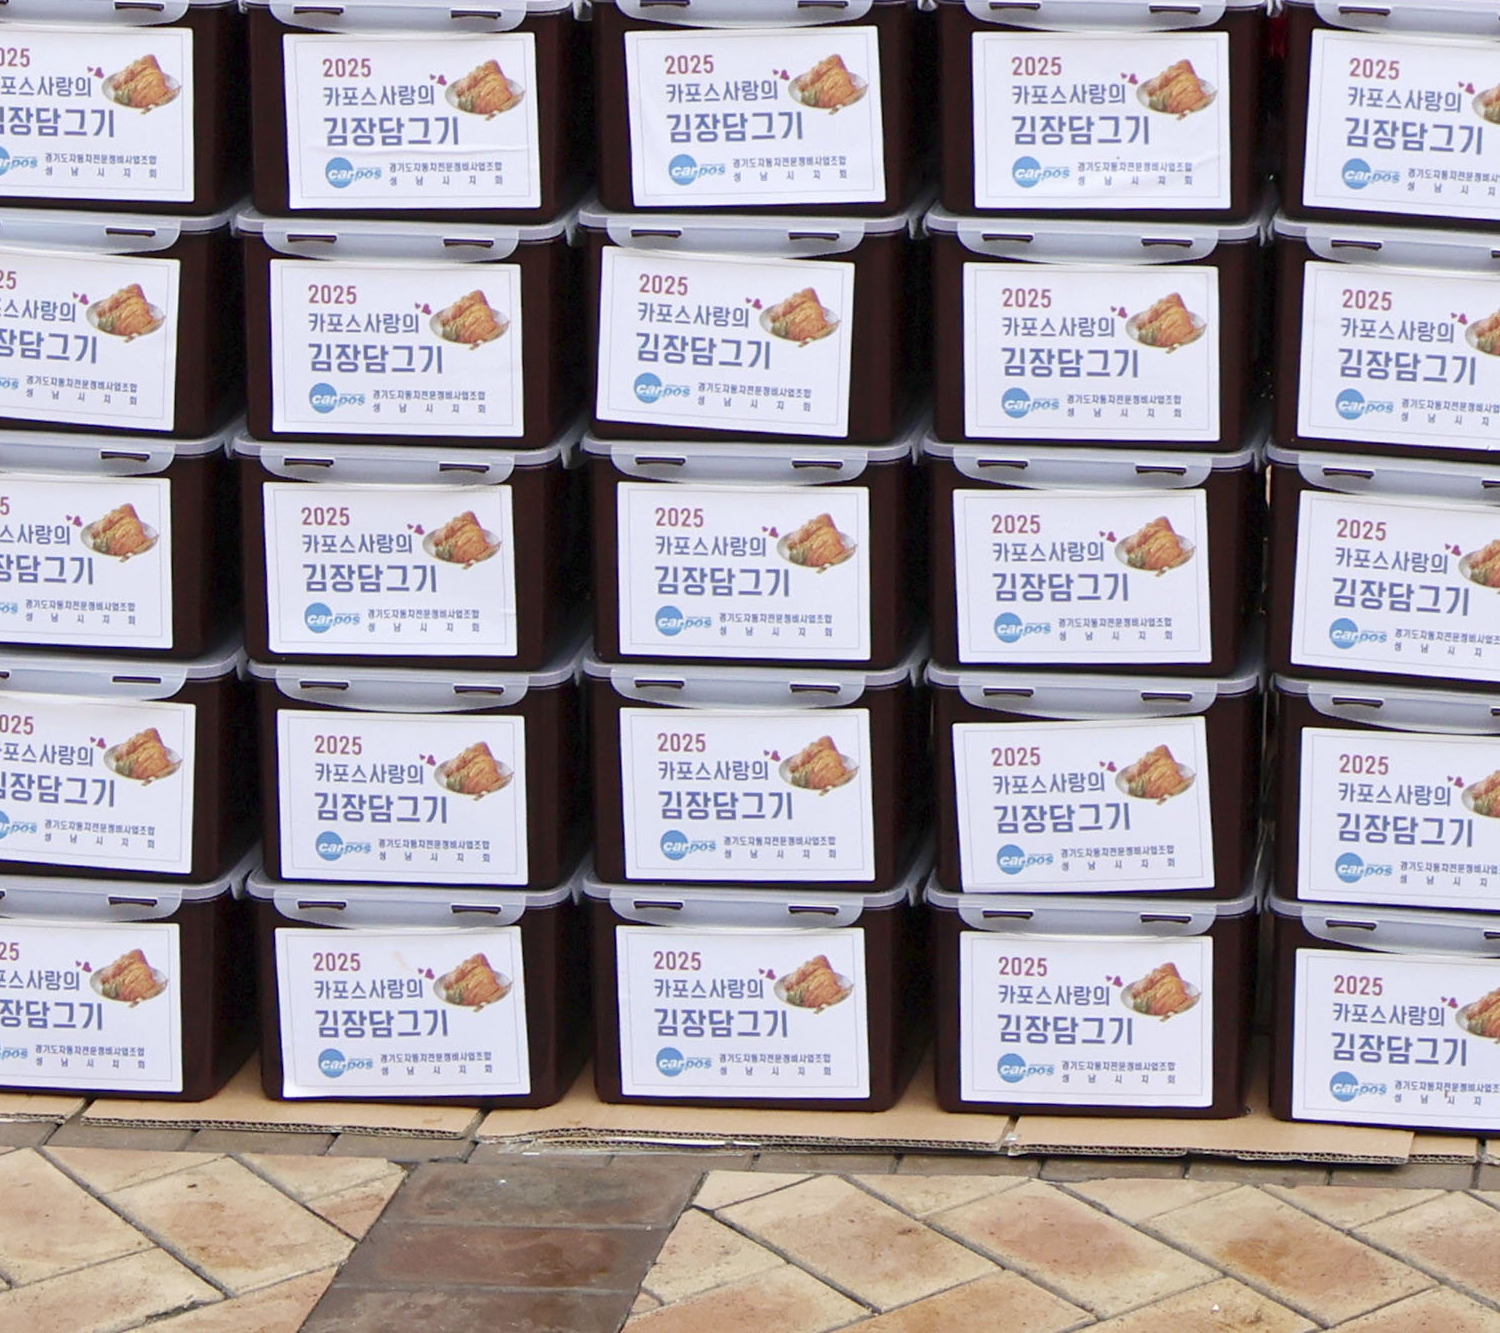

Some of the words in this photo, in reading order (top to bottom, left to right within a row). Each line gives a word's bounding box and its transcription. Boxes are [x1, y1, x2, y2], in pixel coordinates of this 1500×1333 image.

[663, 53, 715, 75] 2025
[665, 80, 779, 104] 카포스사랑의
[666, 110, 804, 144] 김장담그기
[1341, 288, 1393, 311] 2025
[1340, 316, 1455, 344] 카포스사랑의
[1337, 347, 1477, 386] 김장담그기
[654, 507, 704, 528] 2025
[654, 535, 767, 558] 카포스사랑의
[654, 565, 790, 598] 김장담그기
[990, 746, 1041, 767] 2025
[992, 772, 1106, 796] 카포스사랑의
[993, 801, 1131, 835] 김장담그기
[311, 952, 361, 972] 2025
[313, 978, 424, 1000] 카포스사랑의
[1333, 975, 1383, 996] 2025
[314, 1008, 449, 1039] 김장담그기
[1332, 1002, 1446, 1027] 카포스사랑의
[1331, 1032, 1468, 1067] 김장담그기
